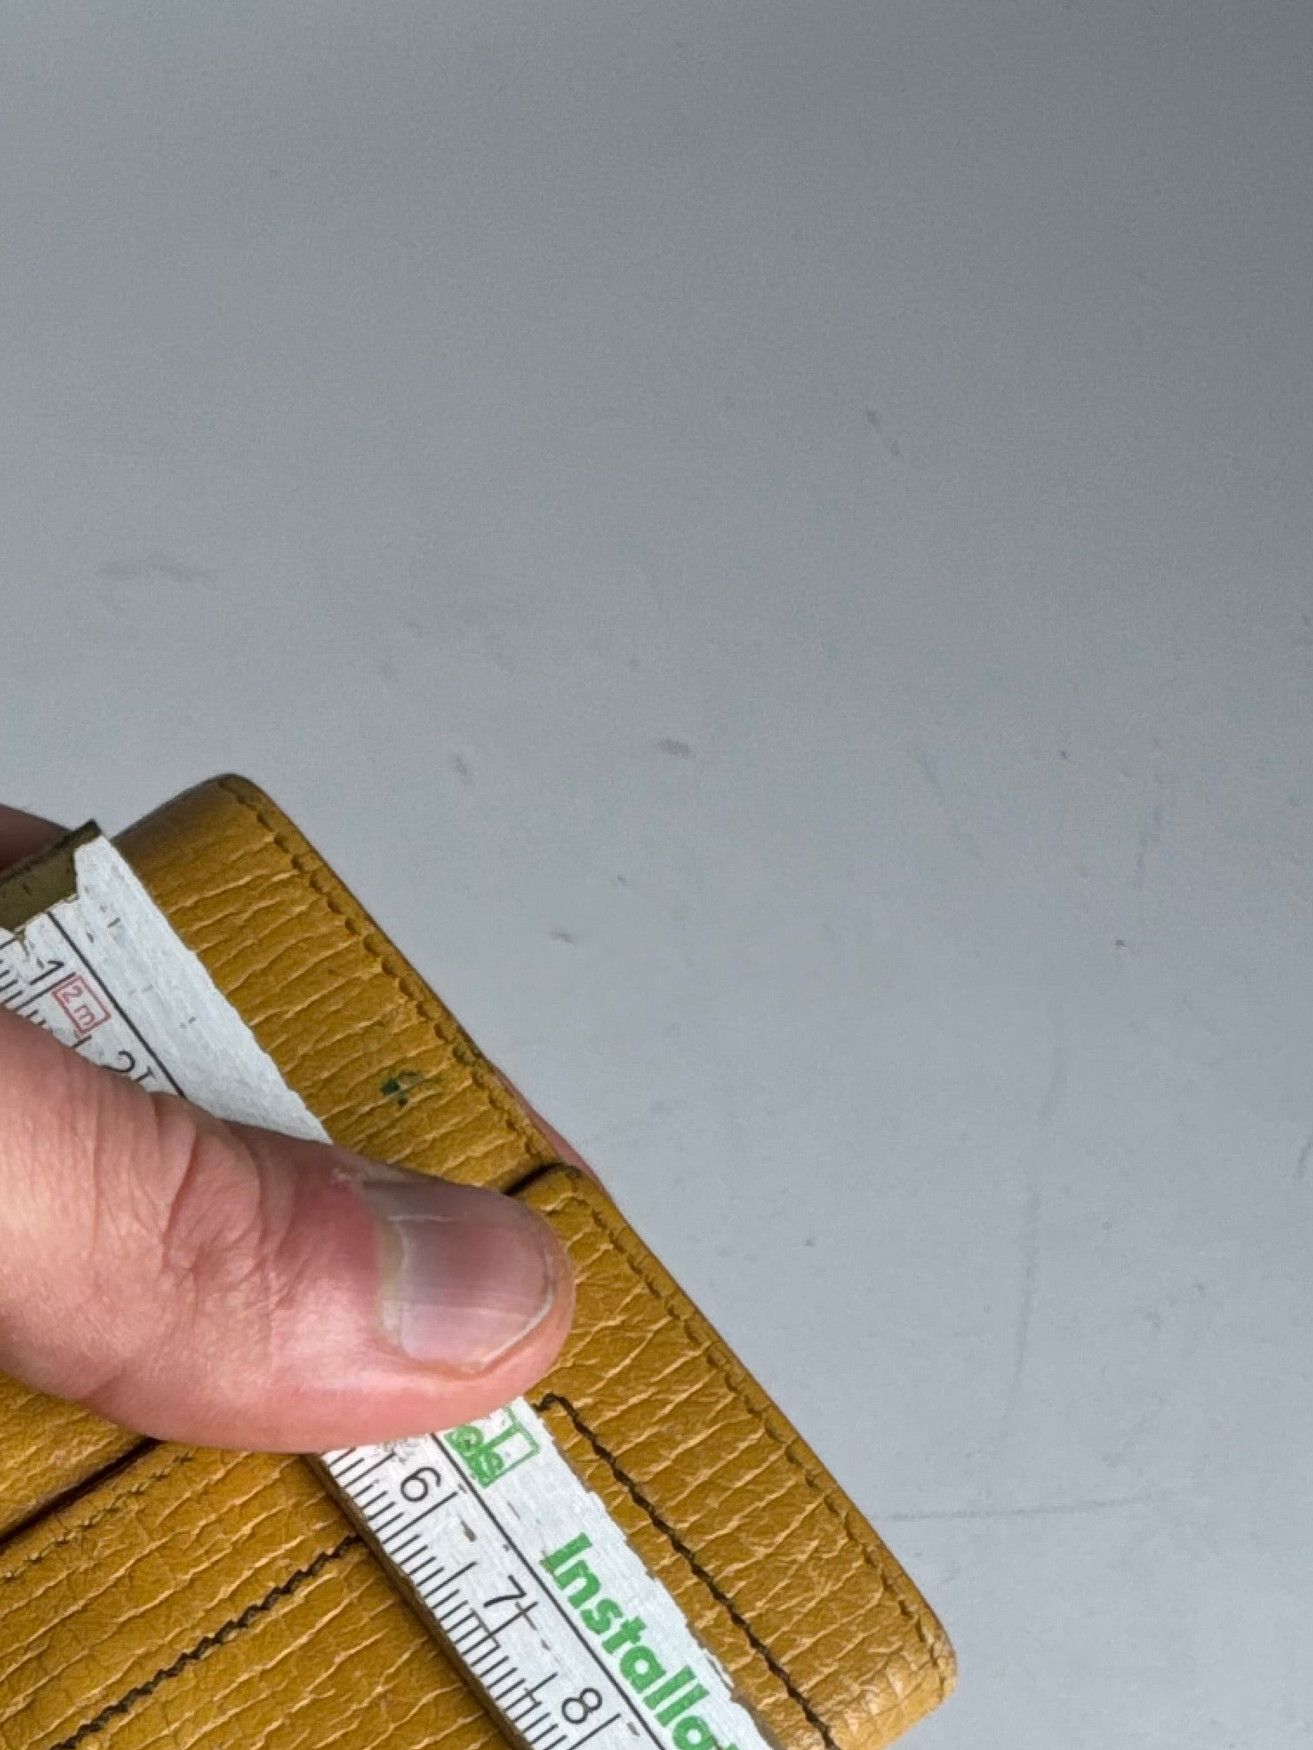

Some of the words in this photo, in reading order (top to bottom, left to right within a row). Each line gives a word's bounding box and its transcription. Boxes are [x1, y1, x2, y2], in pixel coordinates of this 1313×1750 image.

[29, 959, 66, 986] 1
[400, 1466, 442, 1502] 6
[483, 1574, 527, 1609] 7
[561, 1687, 604, 1725] 8
